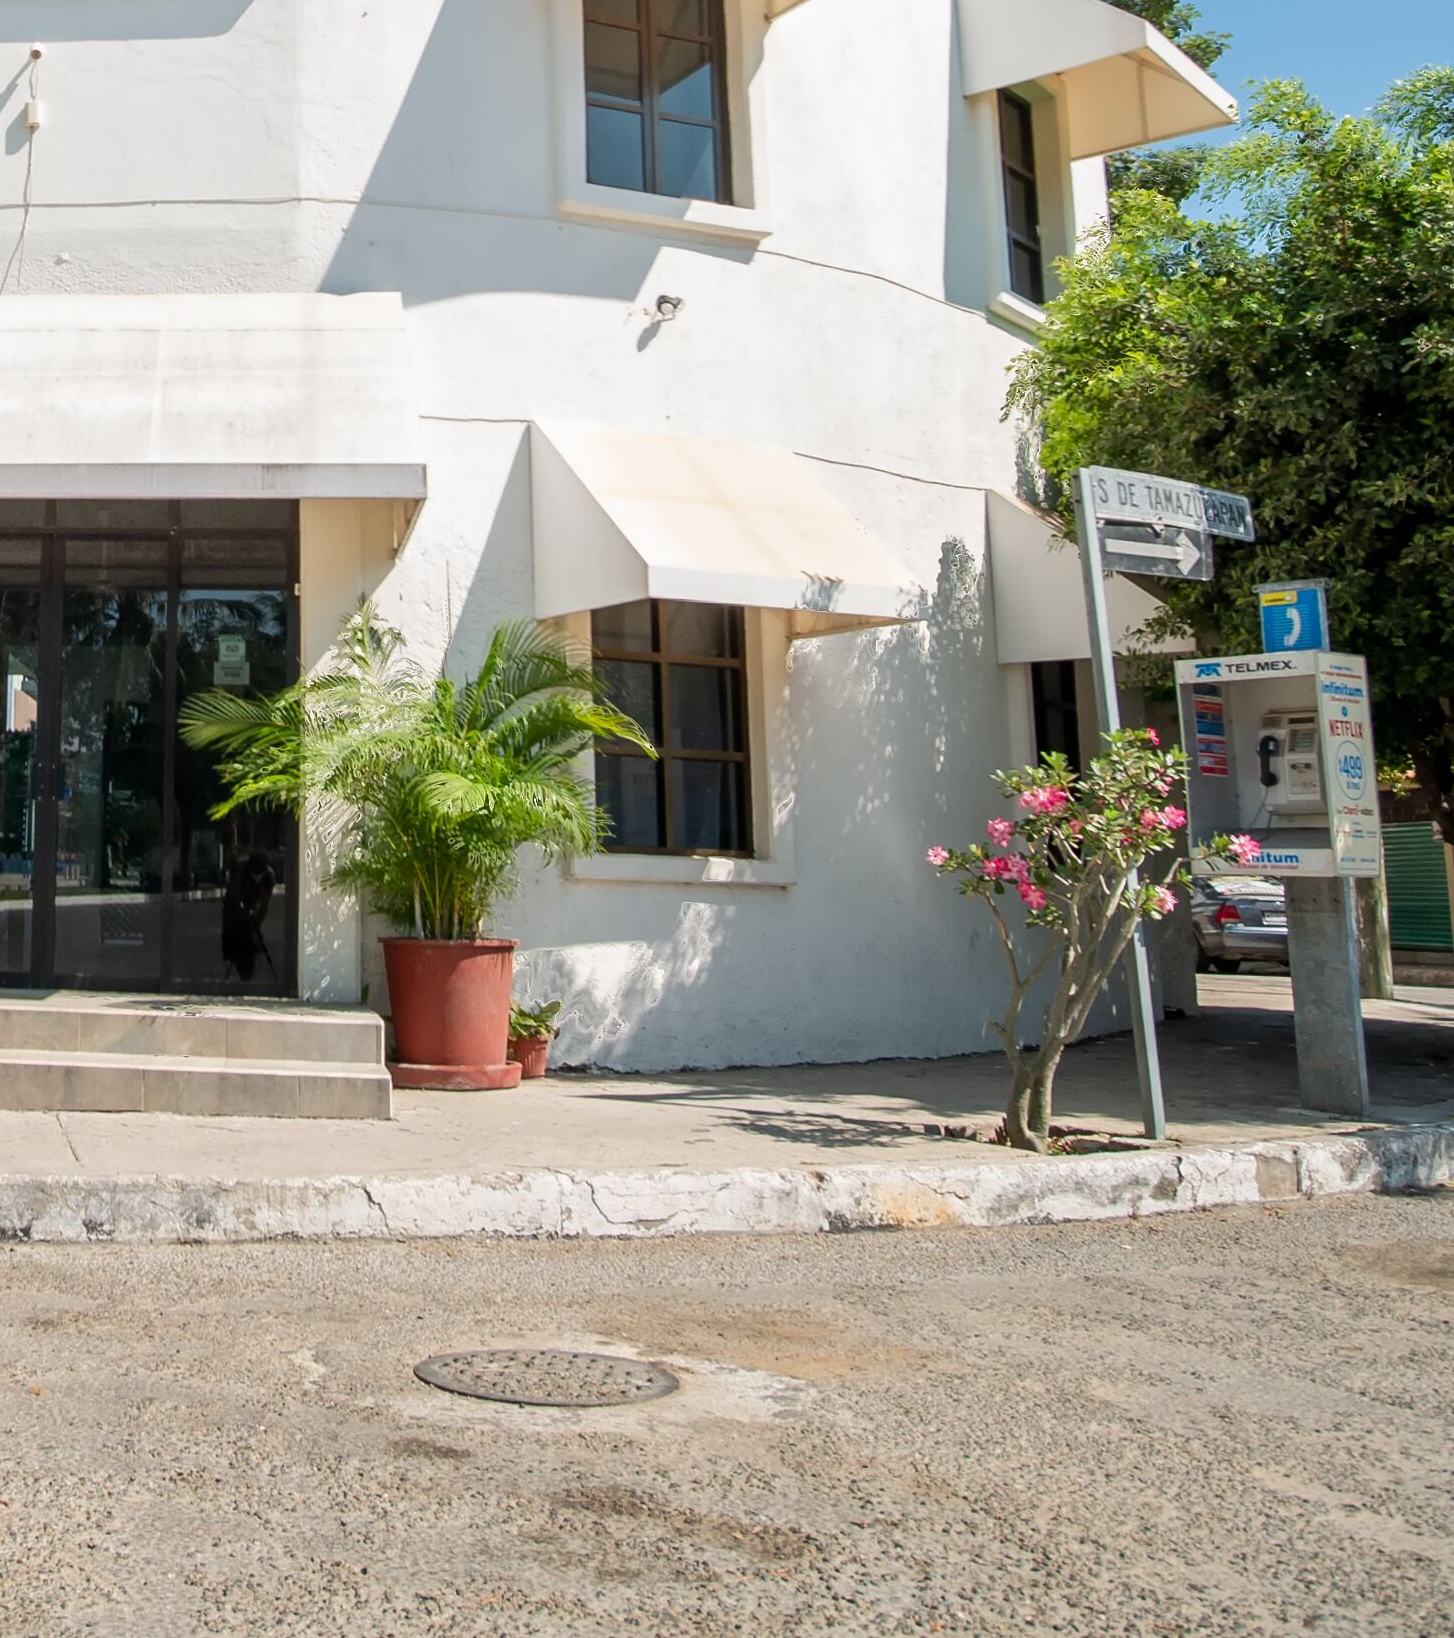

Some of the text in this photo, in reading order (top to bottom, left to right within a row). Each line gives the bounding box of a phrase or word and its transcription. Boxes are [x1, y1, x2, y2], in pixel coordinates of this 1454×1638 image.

[1116, 481, 1139, 508] DE
[1224, 660, 1293, 674] TELMEX
[1329, 719, 1364, 739] NETFLIX
